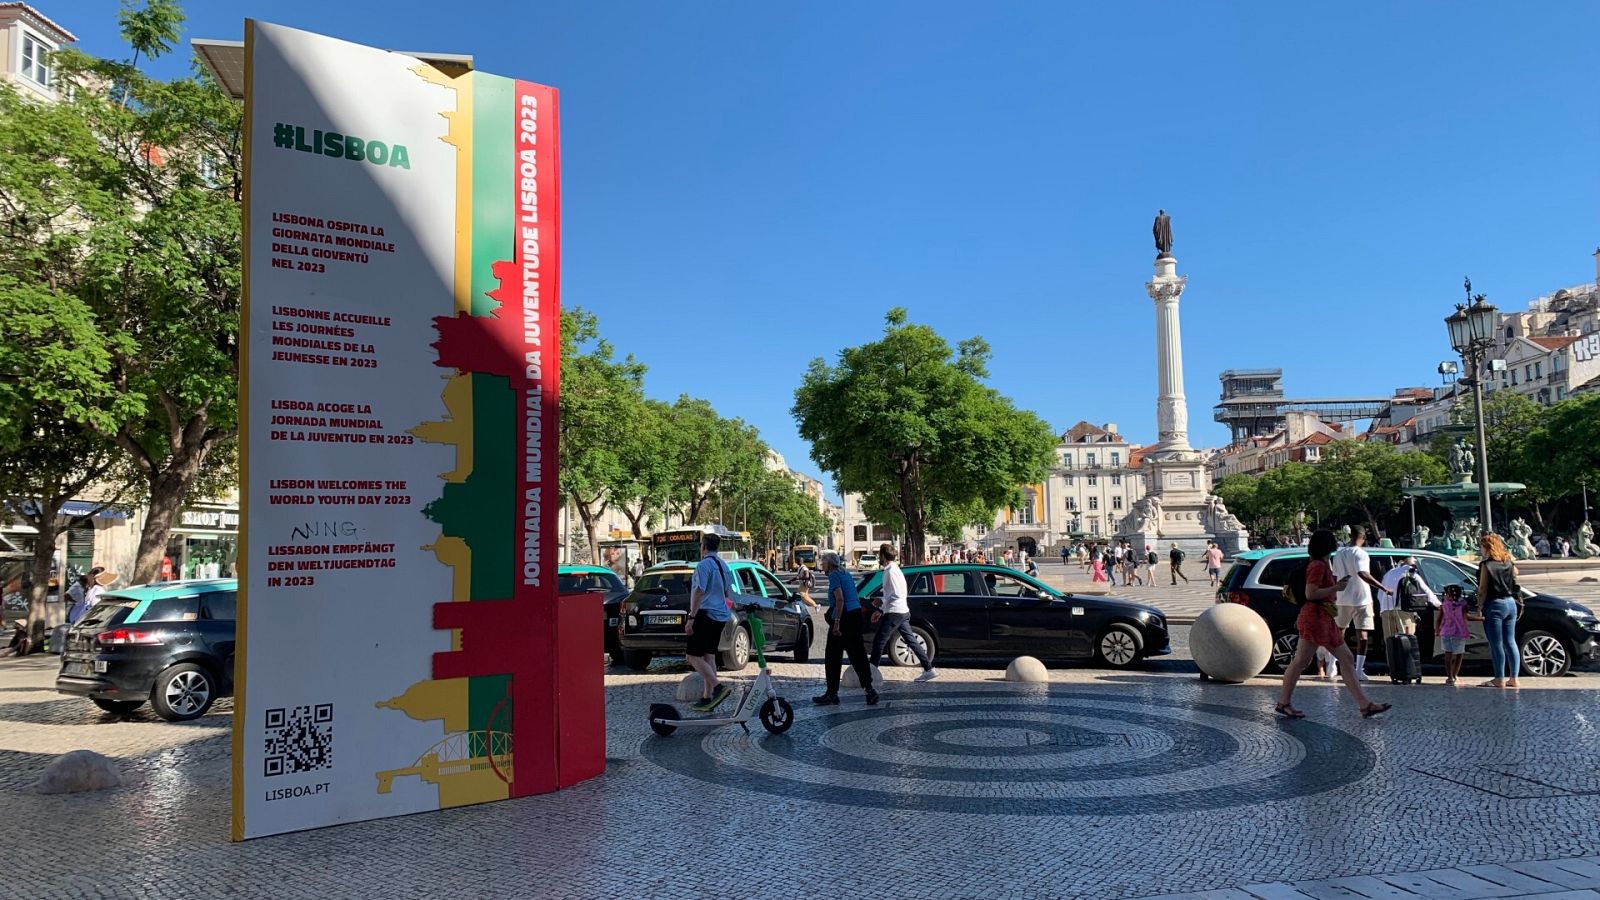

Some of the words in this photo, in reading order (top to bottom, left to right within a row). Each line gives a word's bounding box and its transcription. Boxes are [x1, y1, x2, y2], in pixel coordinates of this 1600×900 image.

[521, 94, 537, 145] 2023
[273, 122, 411, 170] #LISBOA
[521, 150, 538, 223] LISBOA
[272, 212, 324, 228] LISBONA
[327, 220, 369, 235] OSPITA
[371, 226, 384, 237] LA
[272, 228, 333, 244] GIORNATA
[335, 236, 395, 253] MONDIALE
[272, 243, 309, 256] DELLA
[311, 248, 369, 264] GIOVENTÙ
[272, 258, 294, 269] NEL
[297, 261, 325, 273] 2023
[522, 227, 541, 347] JUVENTUDE
[272, 305, 331, 321] LISBONNE
[333, 312, 391, 326] ACCUEILLE
[272, 321, 294, 331] LES
[296, 323, 354, 337] JOURNÉES
[272, 336, 341, 351] MONDIALES
[343, 343, 359, 352] DE
[361, 344, 375, 354] LA
[272, 351, 330, 365] JEUNESSE
[332, 356, 348, 367] EN
[350, 358, 378, 369] 2023
[525, 351, 542, 381] DA
[271, 400, 314, 412] LISBOA
[316, 403, 355, 413] ACOGE
[357, 405, 371, 414] LA
[271, 416, 327, 427] JORNADA
[329, 418, 383, 429] MUNDIAL
[271, 431, 288, 441] DE
[290, 431, 305, 441] LA
[307, 433, 366, 443] JUVENTUD
[369, 435, 385, 444] EN
[387, 435, 414, 445] 2023
[526, 385, 542, 483] MUNDIAL
[270, 480, 315, 489] LISBON
[317, 480, 382, 490] WELCOMES
[385, 481, 407, 490] THE
[270, 495, 315, 505] WORLD
[317, 495, 356, 505] YOUTH
[358, 495, 382, 505] DAY
[384, 495, 411, 505] 2023
[524, 487, 541, 587] JORNADA
[268, 545, 330, 556] LISSABON
[332, 542, 395, 554] EMPFÄNGT
[268, 561, 294, 571] DEN
[297, 558, 396, 571] WELTJUGENDTAG
[268, 577, 281, 587] IN
[284, 576, 314, 587] 2023
[265, 782, 331, 801] LISBOA.PT
